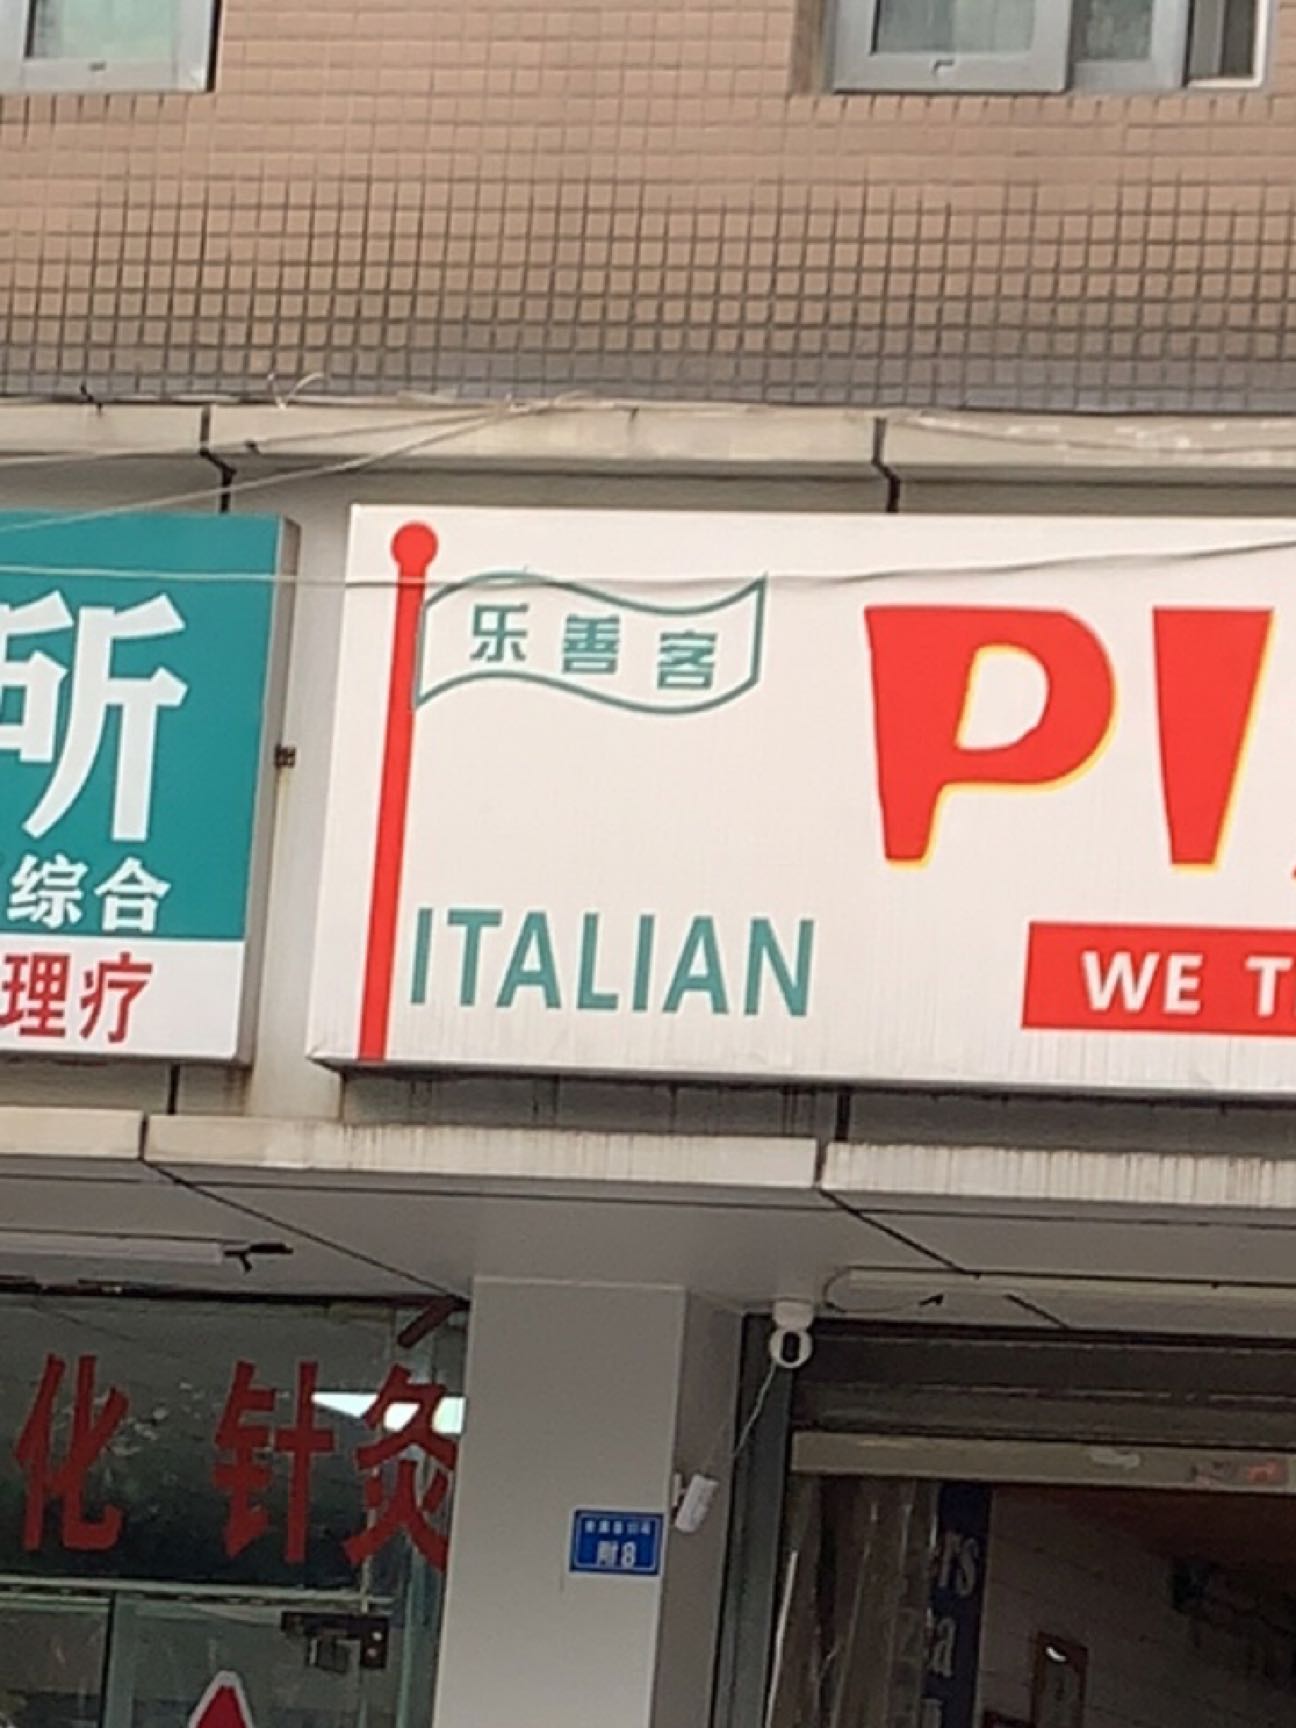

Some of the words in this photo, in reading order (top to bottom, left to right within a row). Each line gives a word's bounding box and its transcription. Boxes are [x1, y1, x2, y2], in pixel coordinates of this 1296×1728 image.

[470, 603, 717, 690] 乐善客
[0, 590, 187, 841] 所
[7, 855, 170, 934] 综合
[0, 952, 153, 1044] 理疗
[412, 908, 815, 1017] ITALIAN
[1081, 951, 1201, 1015] WE
